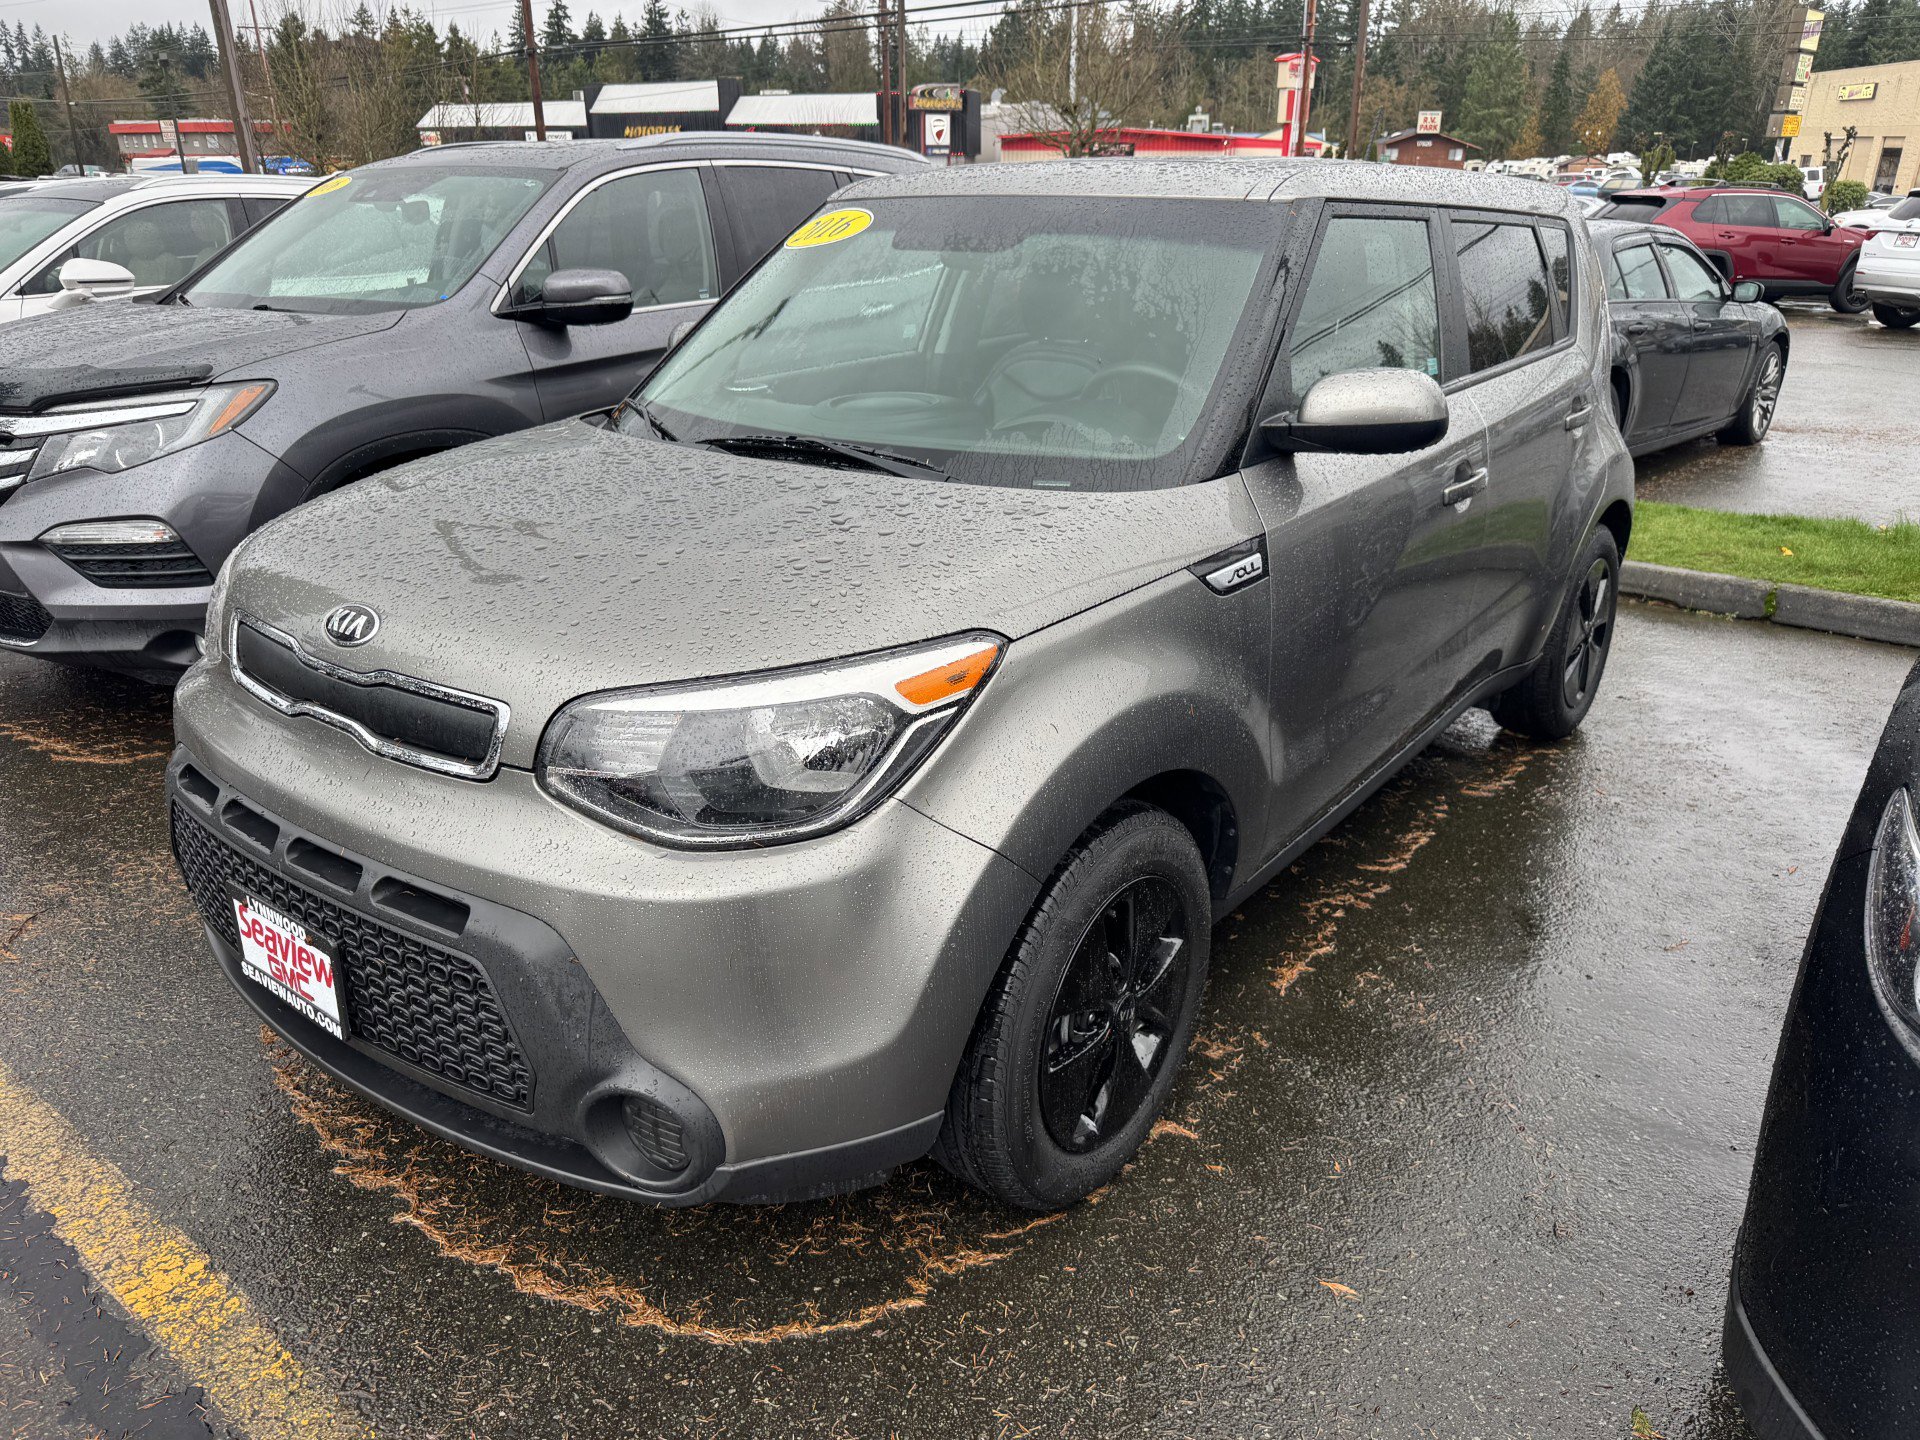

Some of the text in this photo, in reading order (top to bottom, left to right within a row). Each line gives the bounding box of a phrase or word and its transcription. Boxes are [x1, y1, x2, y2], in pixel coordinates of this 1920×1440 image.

[791, 215, 865, 243] 2016
[327, 608, 368, 639] KIA
[245, 895, 307, 941] LYNNWOOD
[238, 905, 334, 989] Seaview
[241, 960, 343, 1041] SEAVIEWAUTO.COM
[267, 953, 315, 1002] GMC
